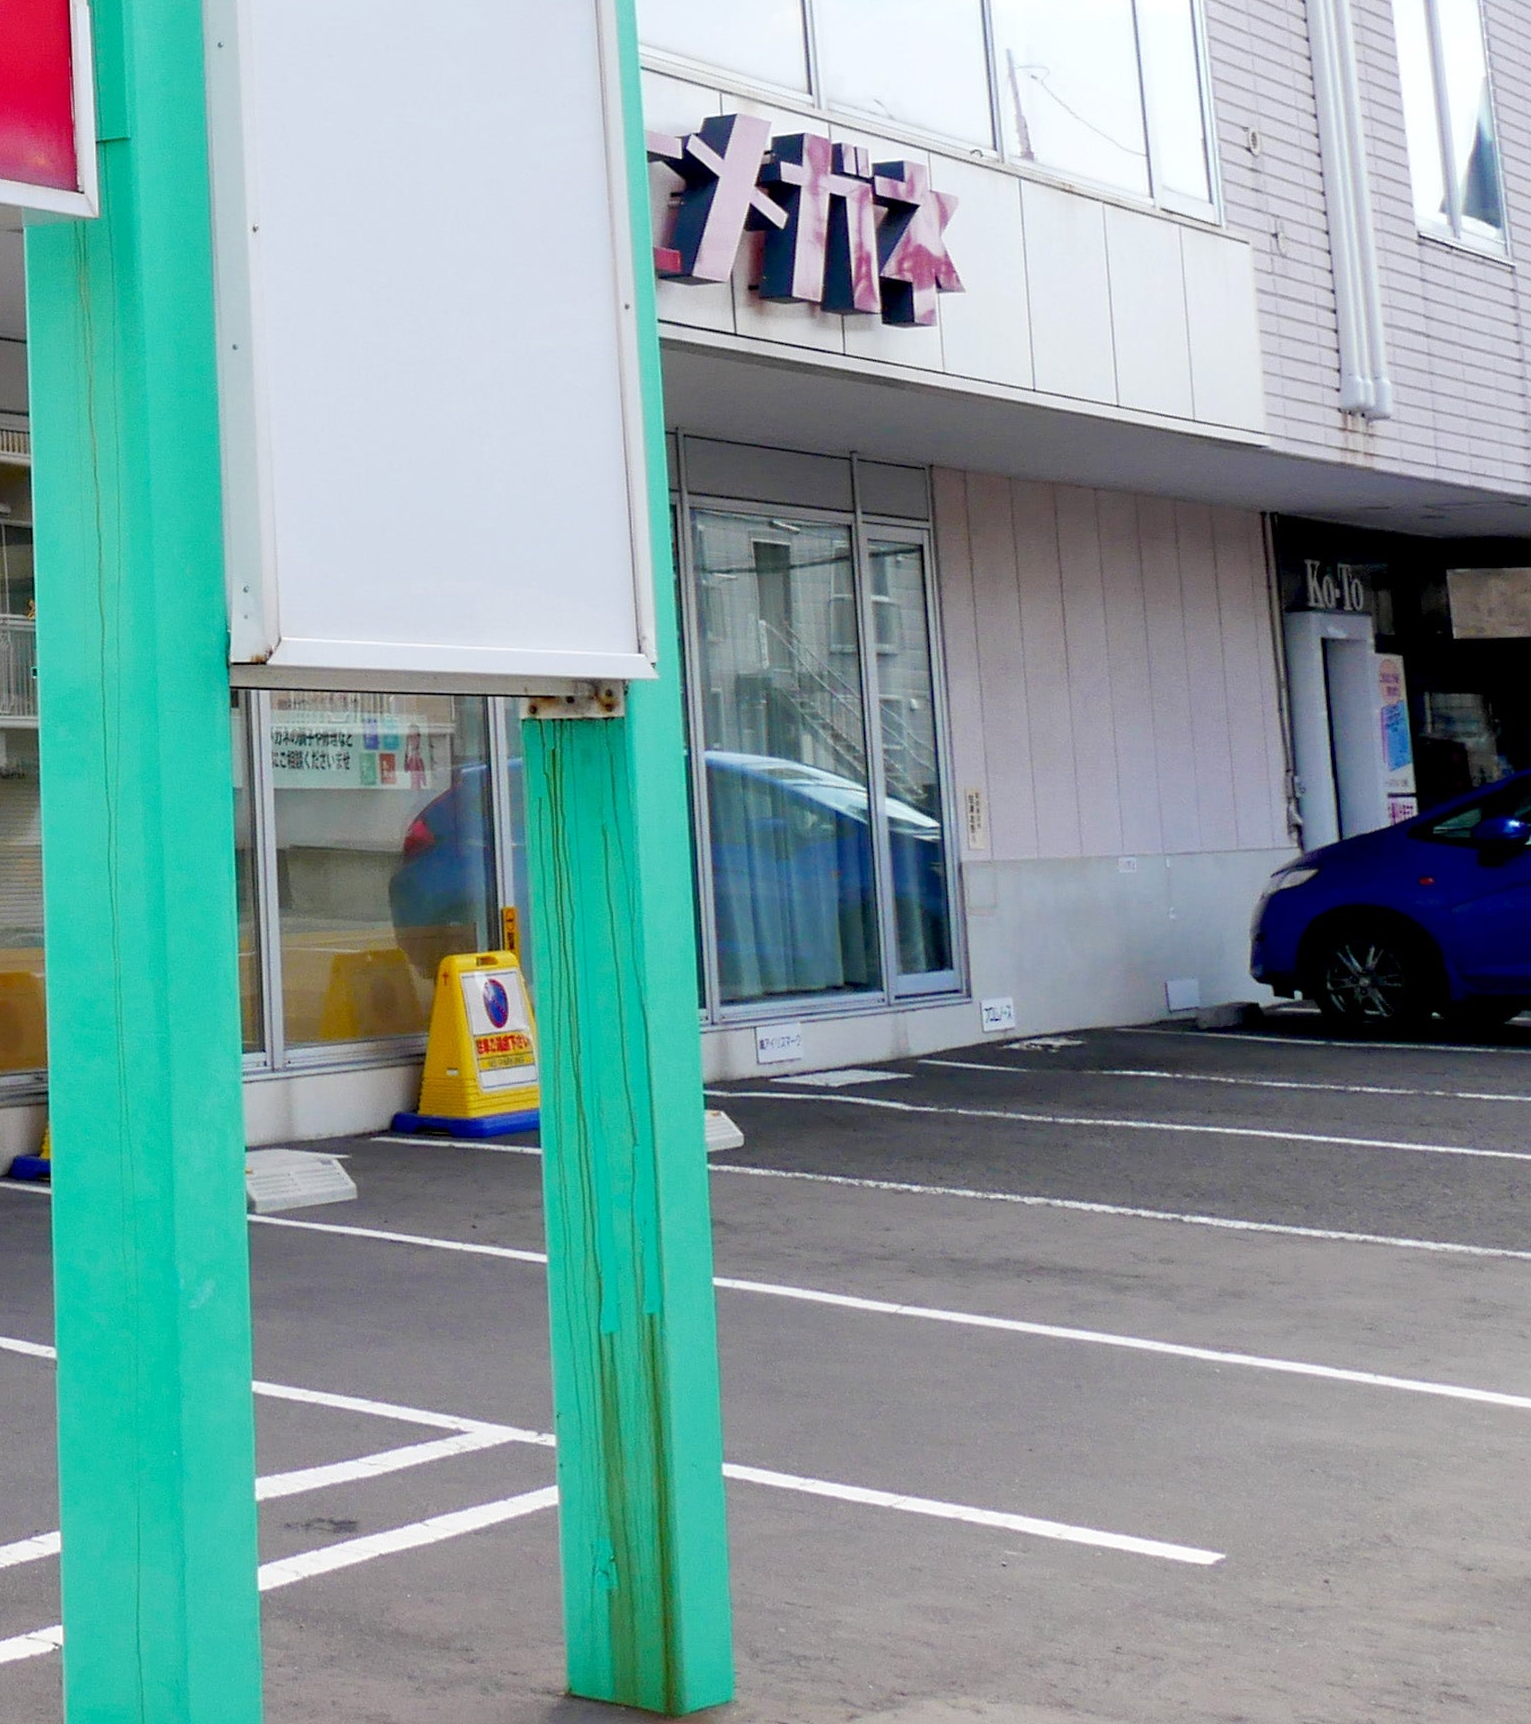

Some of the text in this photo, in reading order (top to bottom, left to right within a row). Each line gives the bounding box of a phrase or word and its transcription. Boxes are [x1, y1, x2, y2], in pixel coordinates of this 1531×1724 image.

[643, 113, 967, 328] メガネ
[1304, 558, 1364, 612] Ko-To
